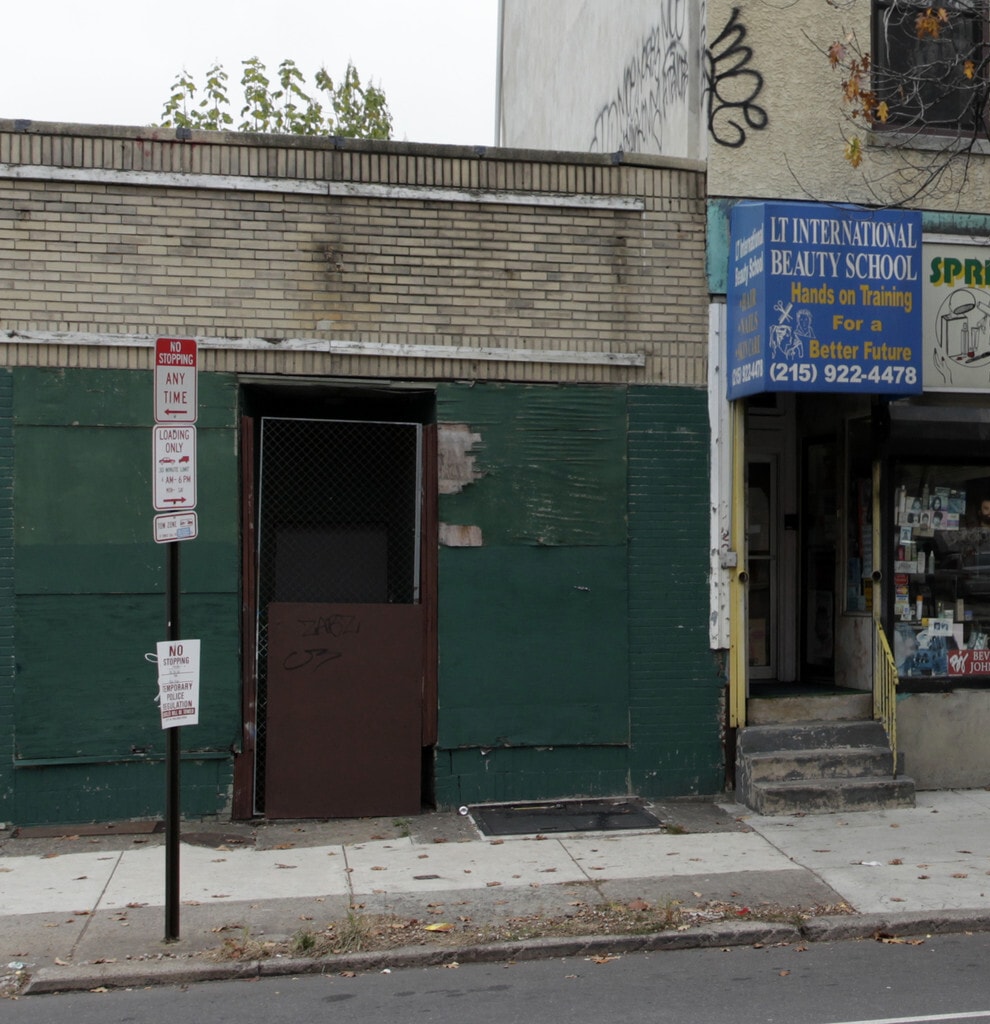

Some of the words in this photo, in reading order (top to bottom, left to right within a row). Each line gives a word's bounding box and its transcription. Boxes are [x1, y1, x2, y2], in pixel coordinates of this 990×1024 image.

[770, 216, 788, 243] LT
[792, 217, 917, 249] INTERNATIONAL
[770, 249, 842, 278] BEAUTY
[845, 252, 917, 281] SCHOOL
[791, 281, 835, 305] Hands
[839, 289, 856, 305] on
[860, 284, 912, 313] Training
[832, 315, 864, 331] For
[871, 320, 882, 332] a
[170, 341, 182, 353] NO
[809, 339, 859, 359] Better
[863, 341, 912, 361] Future
[159, 353, 194, 365] STOPPING
[166, 372, 186, 385] ANY
[769, 362, 818, 384] (215)
[824, 364, 917, 385] 922-4478
[164, 391, 188, 404] TIME
[159, 430, 190, 441] LOADING
[165, 442, 183, 453] ONLY
[169, 644, 184, 656] NO
[163, 657, 190, 666] STOPPING
[166, 692, 184, 701] POLICE
